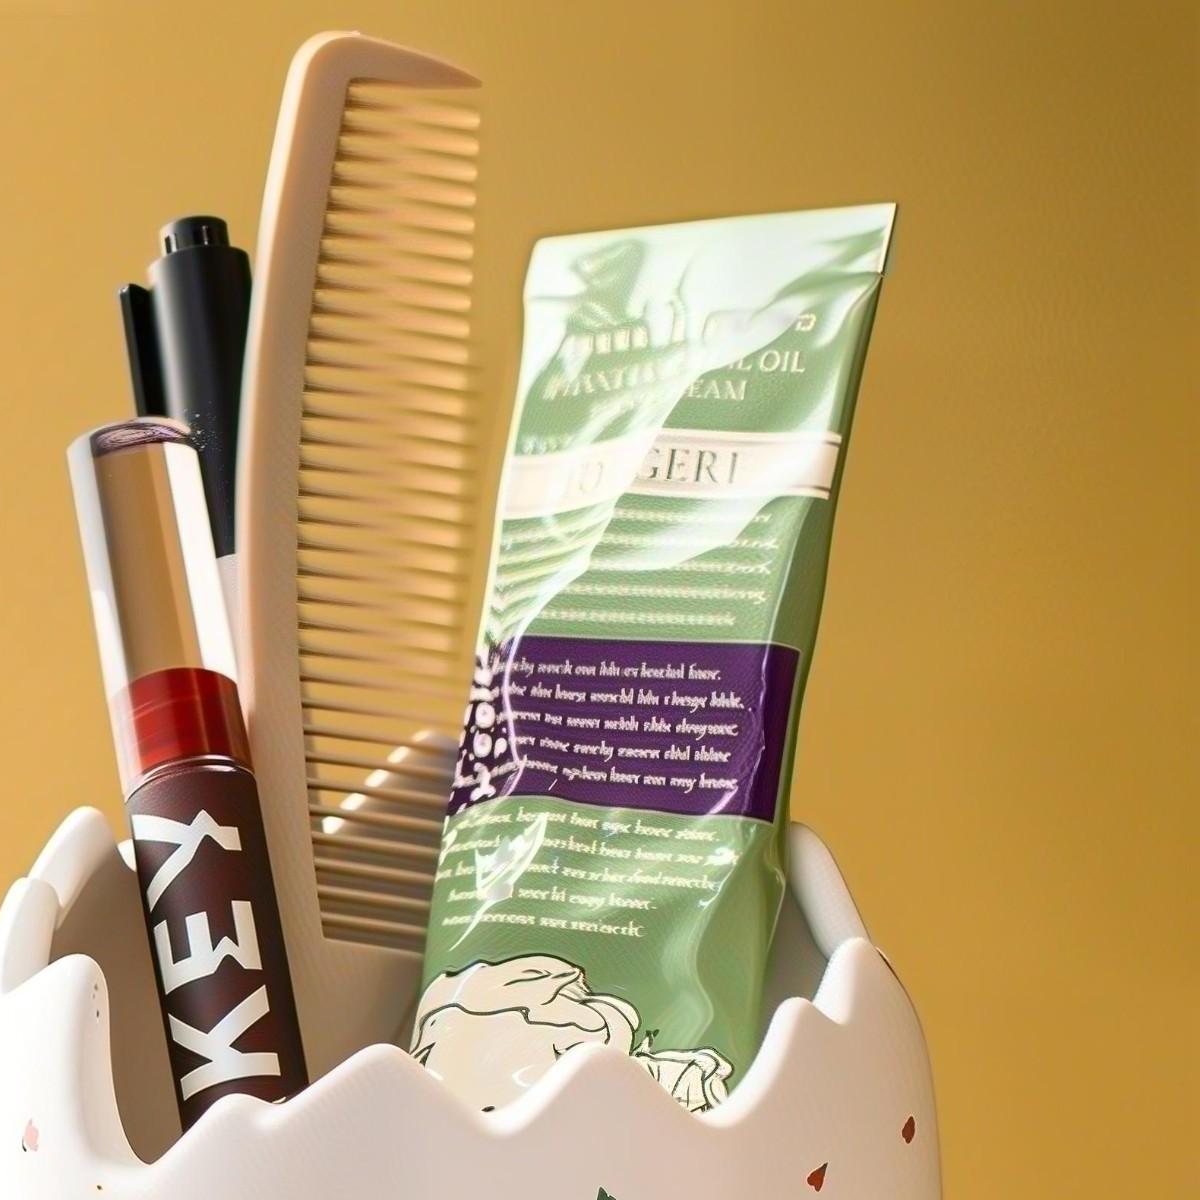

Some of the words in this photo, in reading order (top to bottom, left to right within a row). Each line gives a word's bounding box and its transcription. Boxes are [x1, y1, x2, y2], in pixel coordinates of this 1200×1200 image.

[759, 349, 806, 374] OIL
[683, 379, 748, 401] EAM
[131, 809, 282, 1101] KEY
